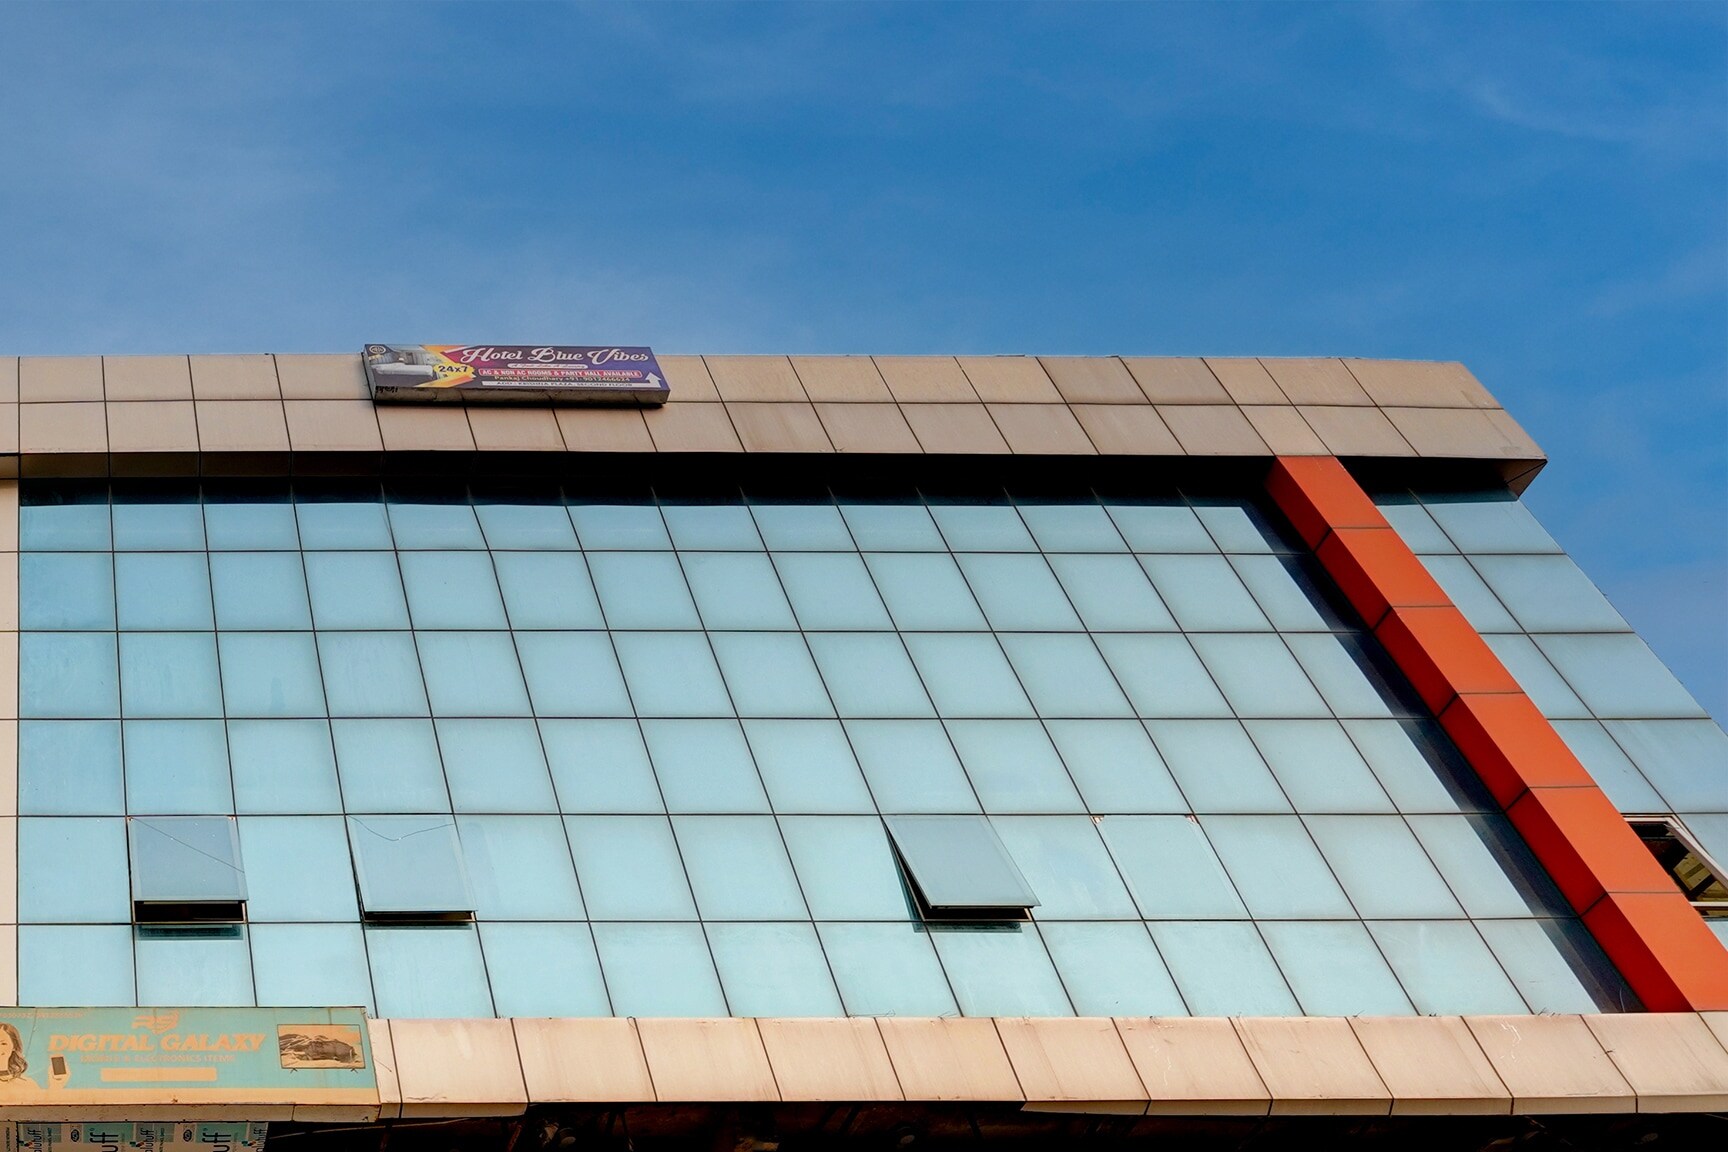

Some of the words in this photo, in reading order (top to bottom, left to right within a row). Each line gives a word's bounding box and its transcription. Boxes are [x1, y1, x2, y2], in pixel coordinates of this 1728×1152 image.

[460, 347, 523, 363] Hotel
[527, 347, 584, 362] Blue
[587, 348, 649, 365] Vibes
[438, 365, 469, 374] 24x7
[47, 1034, 155, 1052] DIGITAL
[162, 1034, 266, 1052] GALAXY
